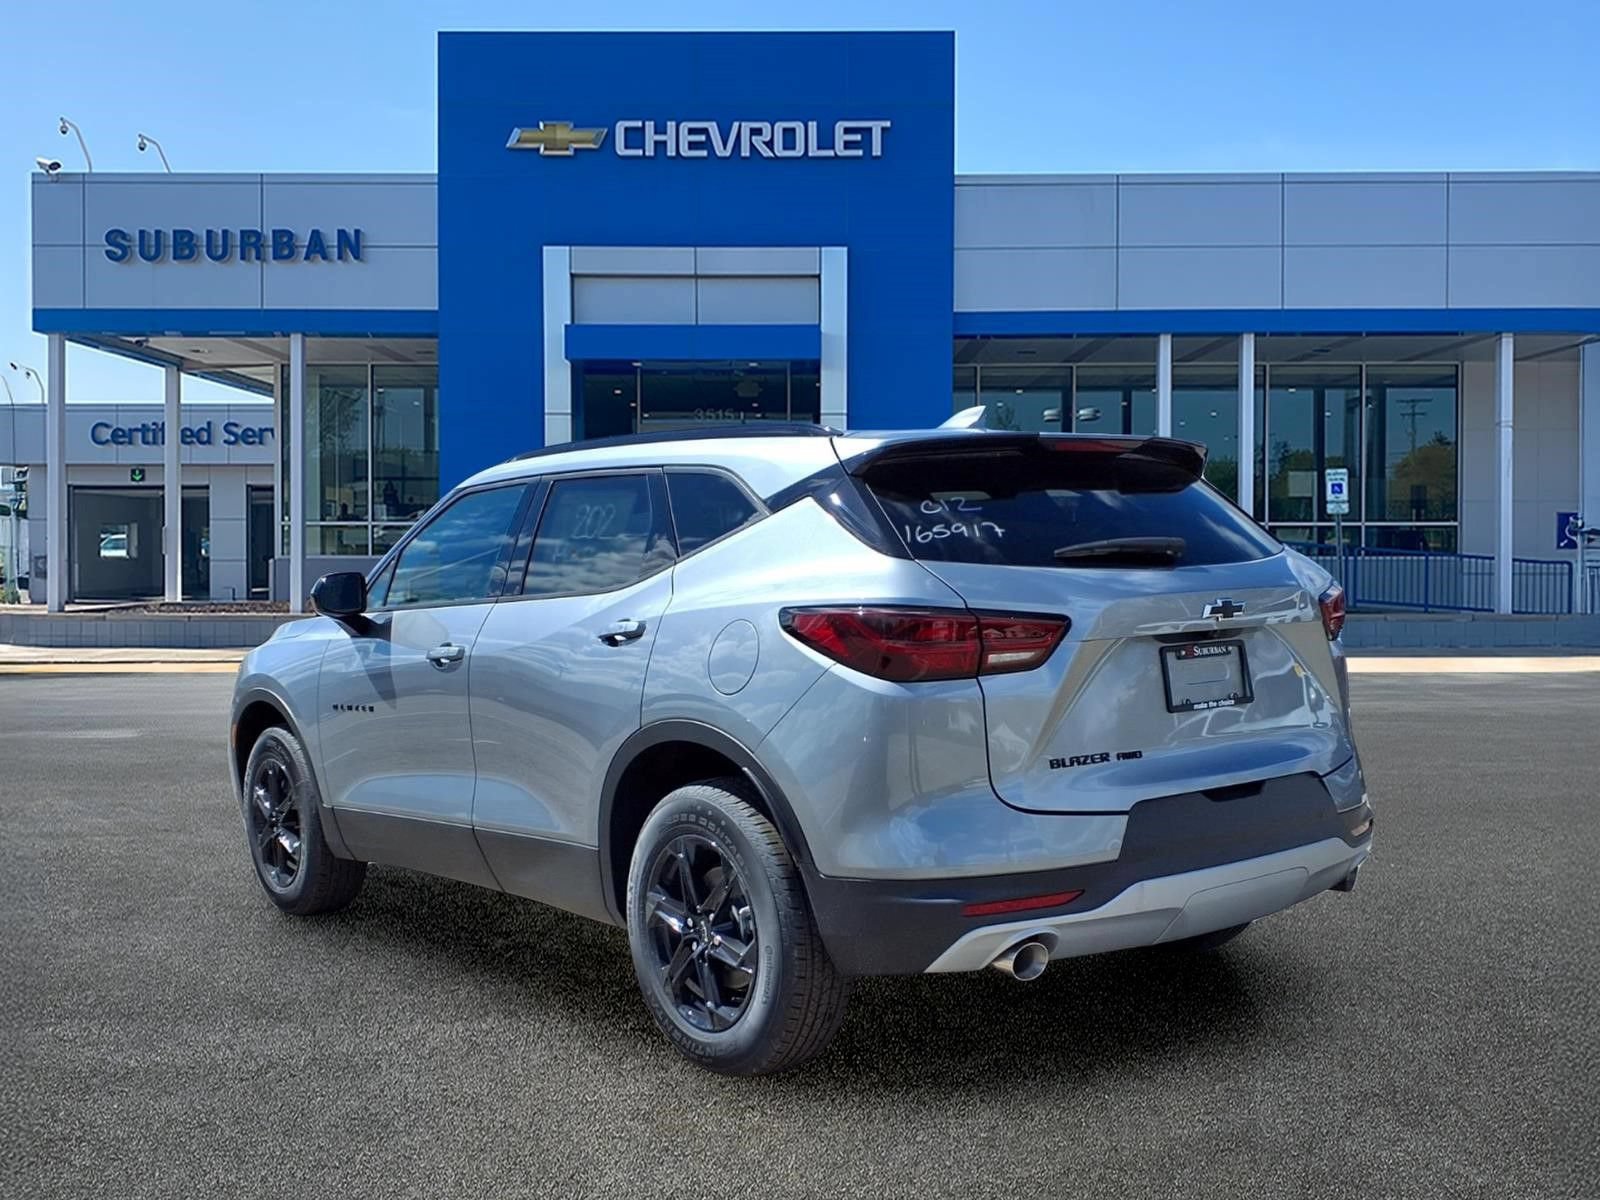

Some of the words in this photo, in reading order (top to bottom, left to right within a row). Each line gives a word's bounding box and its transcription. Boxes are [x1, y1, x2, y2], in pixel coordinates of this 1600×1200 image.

[614, 120, 892, 158] CHEVROLET
[104, 228, 364, 263] SUBURBAN
[91, 421, 213, 446] Certifed
[904, 521, 1006, 544] 165917
[1048, 751, 1111, 770] BLAZER
[1116, 750, 1143, 761] AWD
